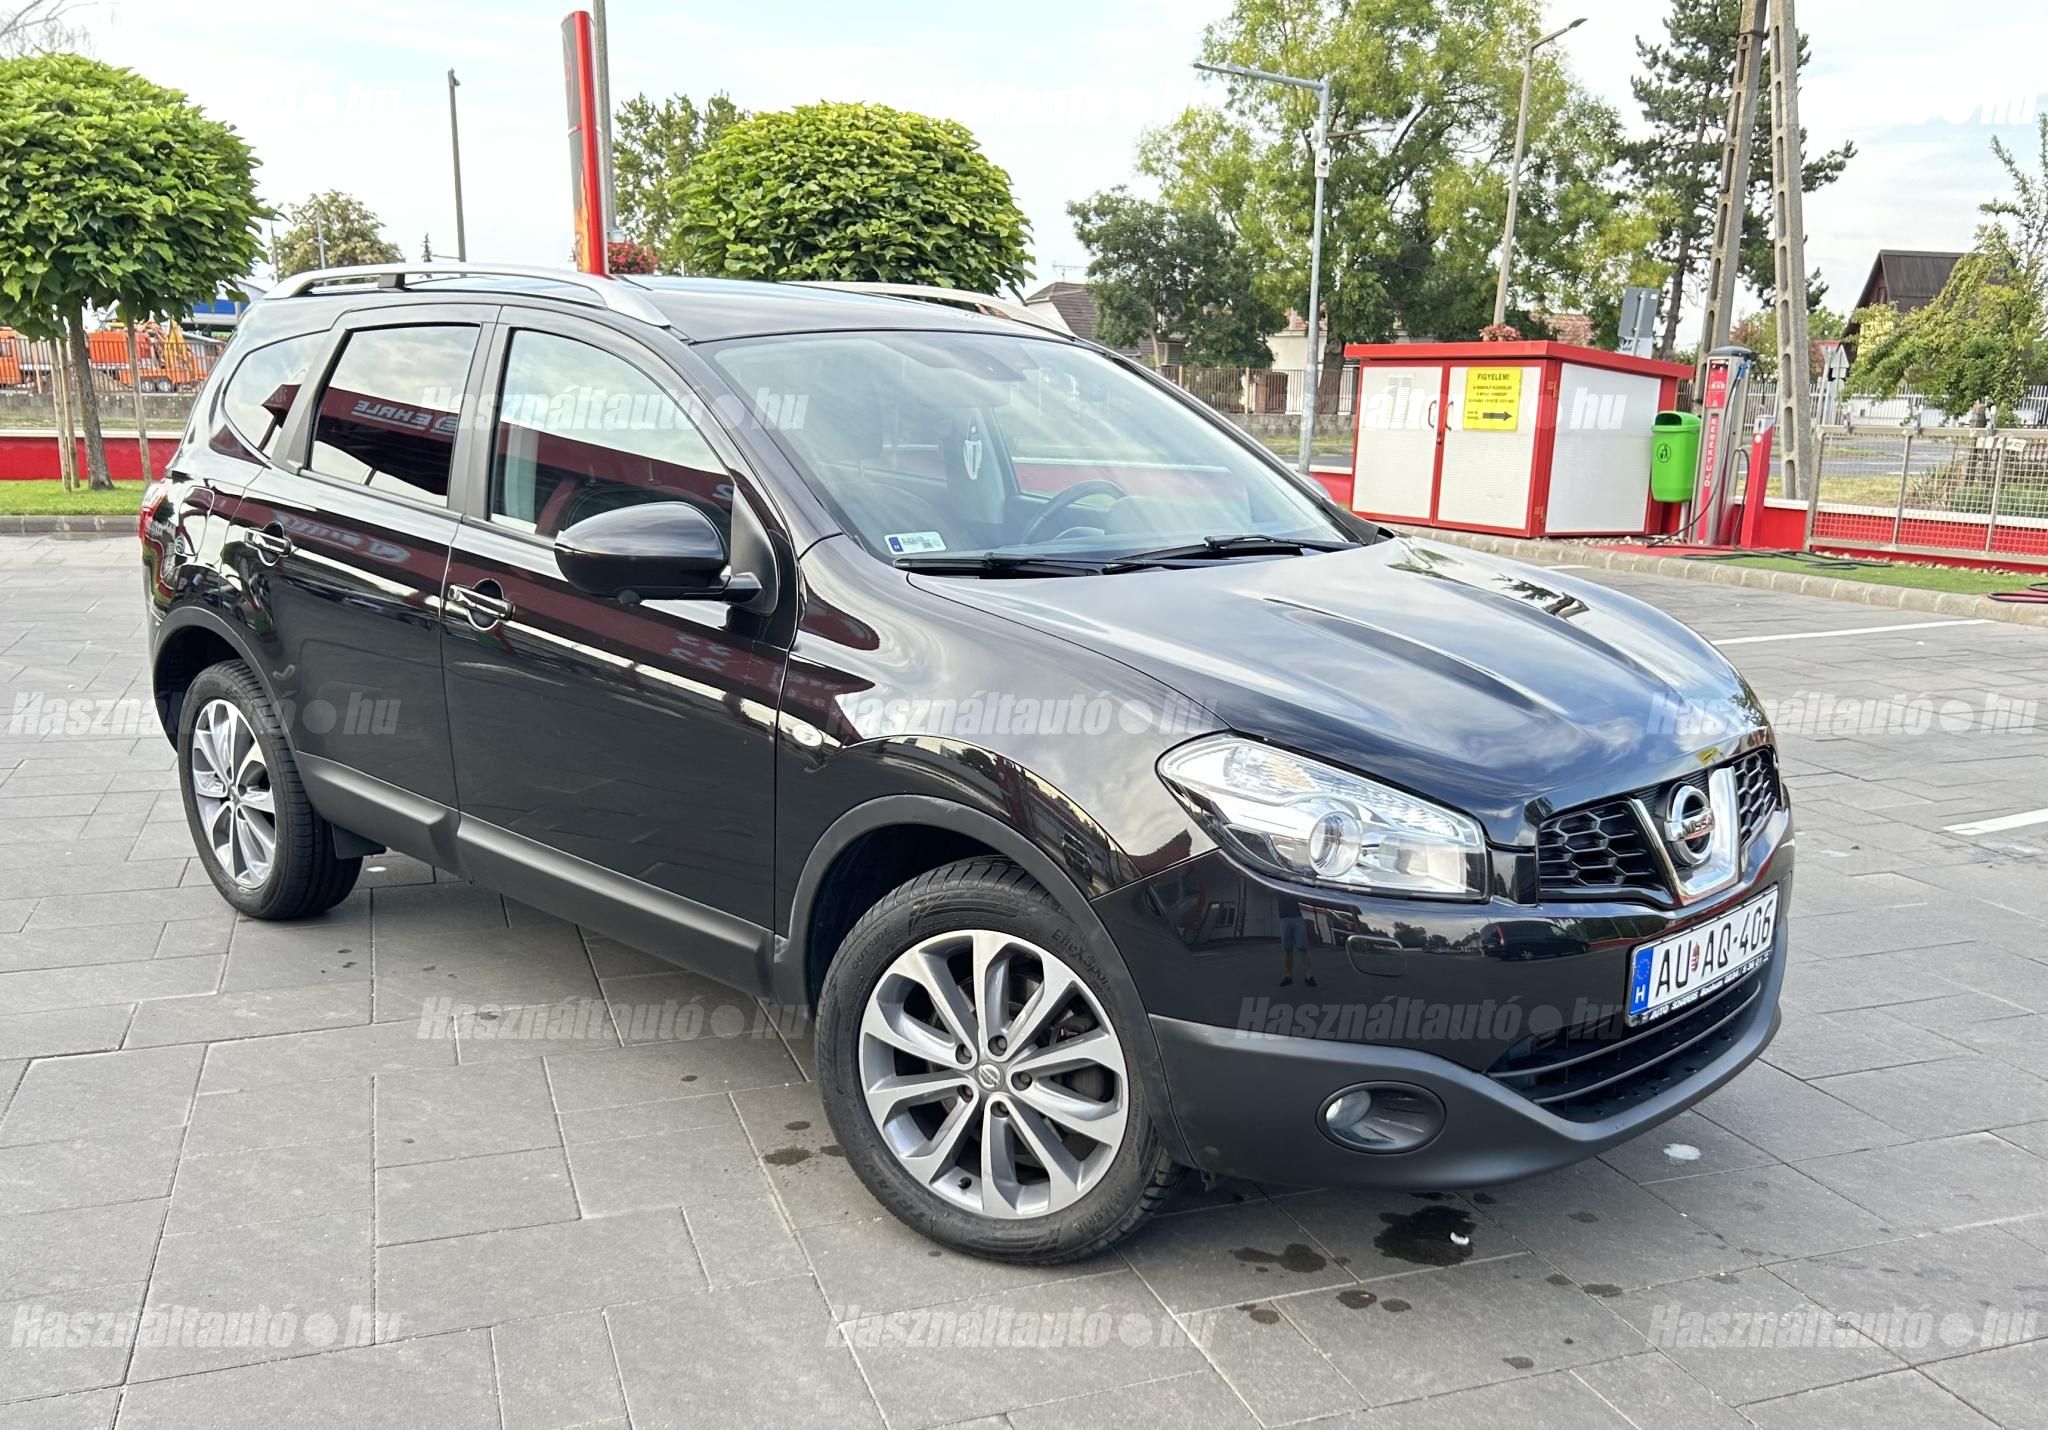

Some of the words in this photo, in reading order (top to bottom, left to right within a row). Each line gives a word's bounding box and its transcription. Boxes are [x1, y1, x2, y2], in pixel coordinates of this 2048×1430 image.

[1477, 373, 1510, 381] FIGYELEM!
[1681, 812, 1713, 837] NISSA
[1655, 939, 1692, 998] AU
[1634, 984, 1646, 1004] H
